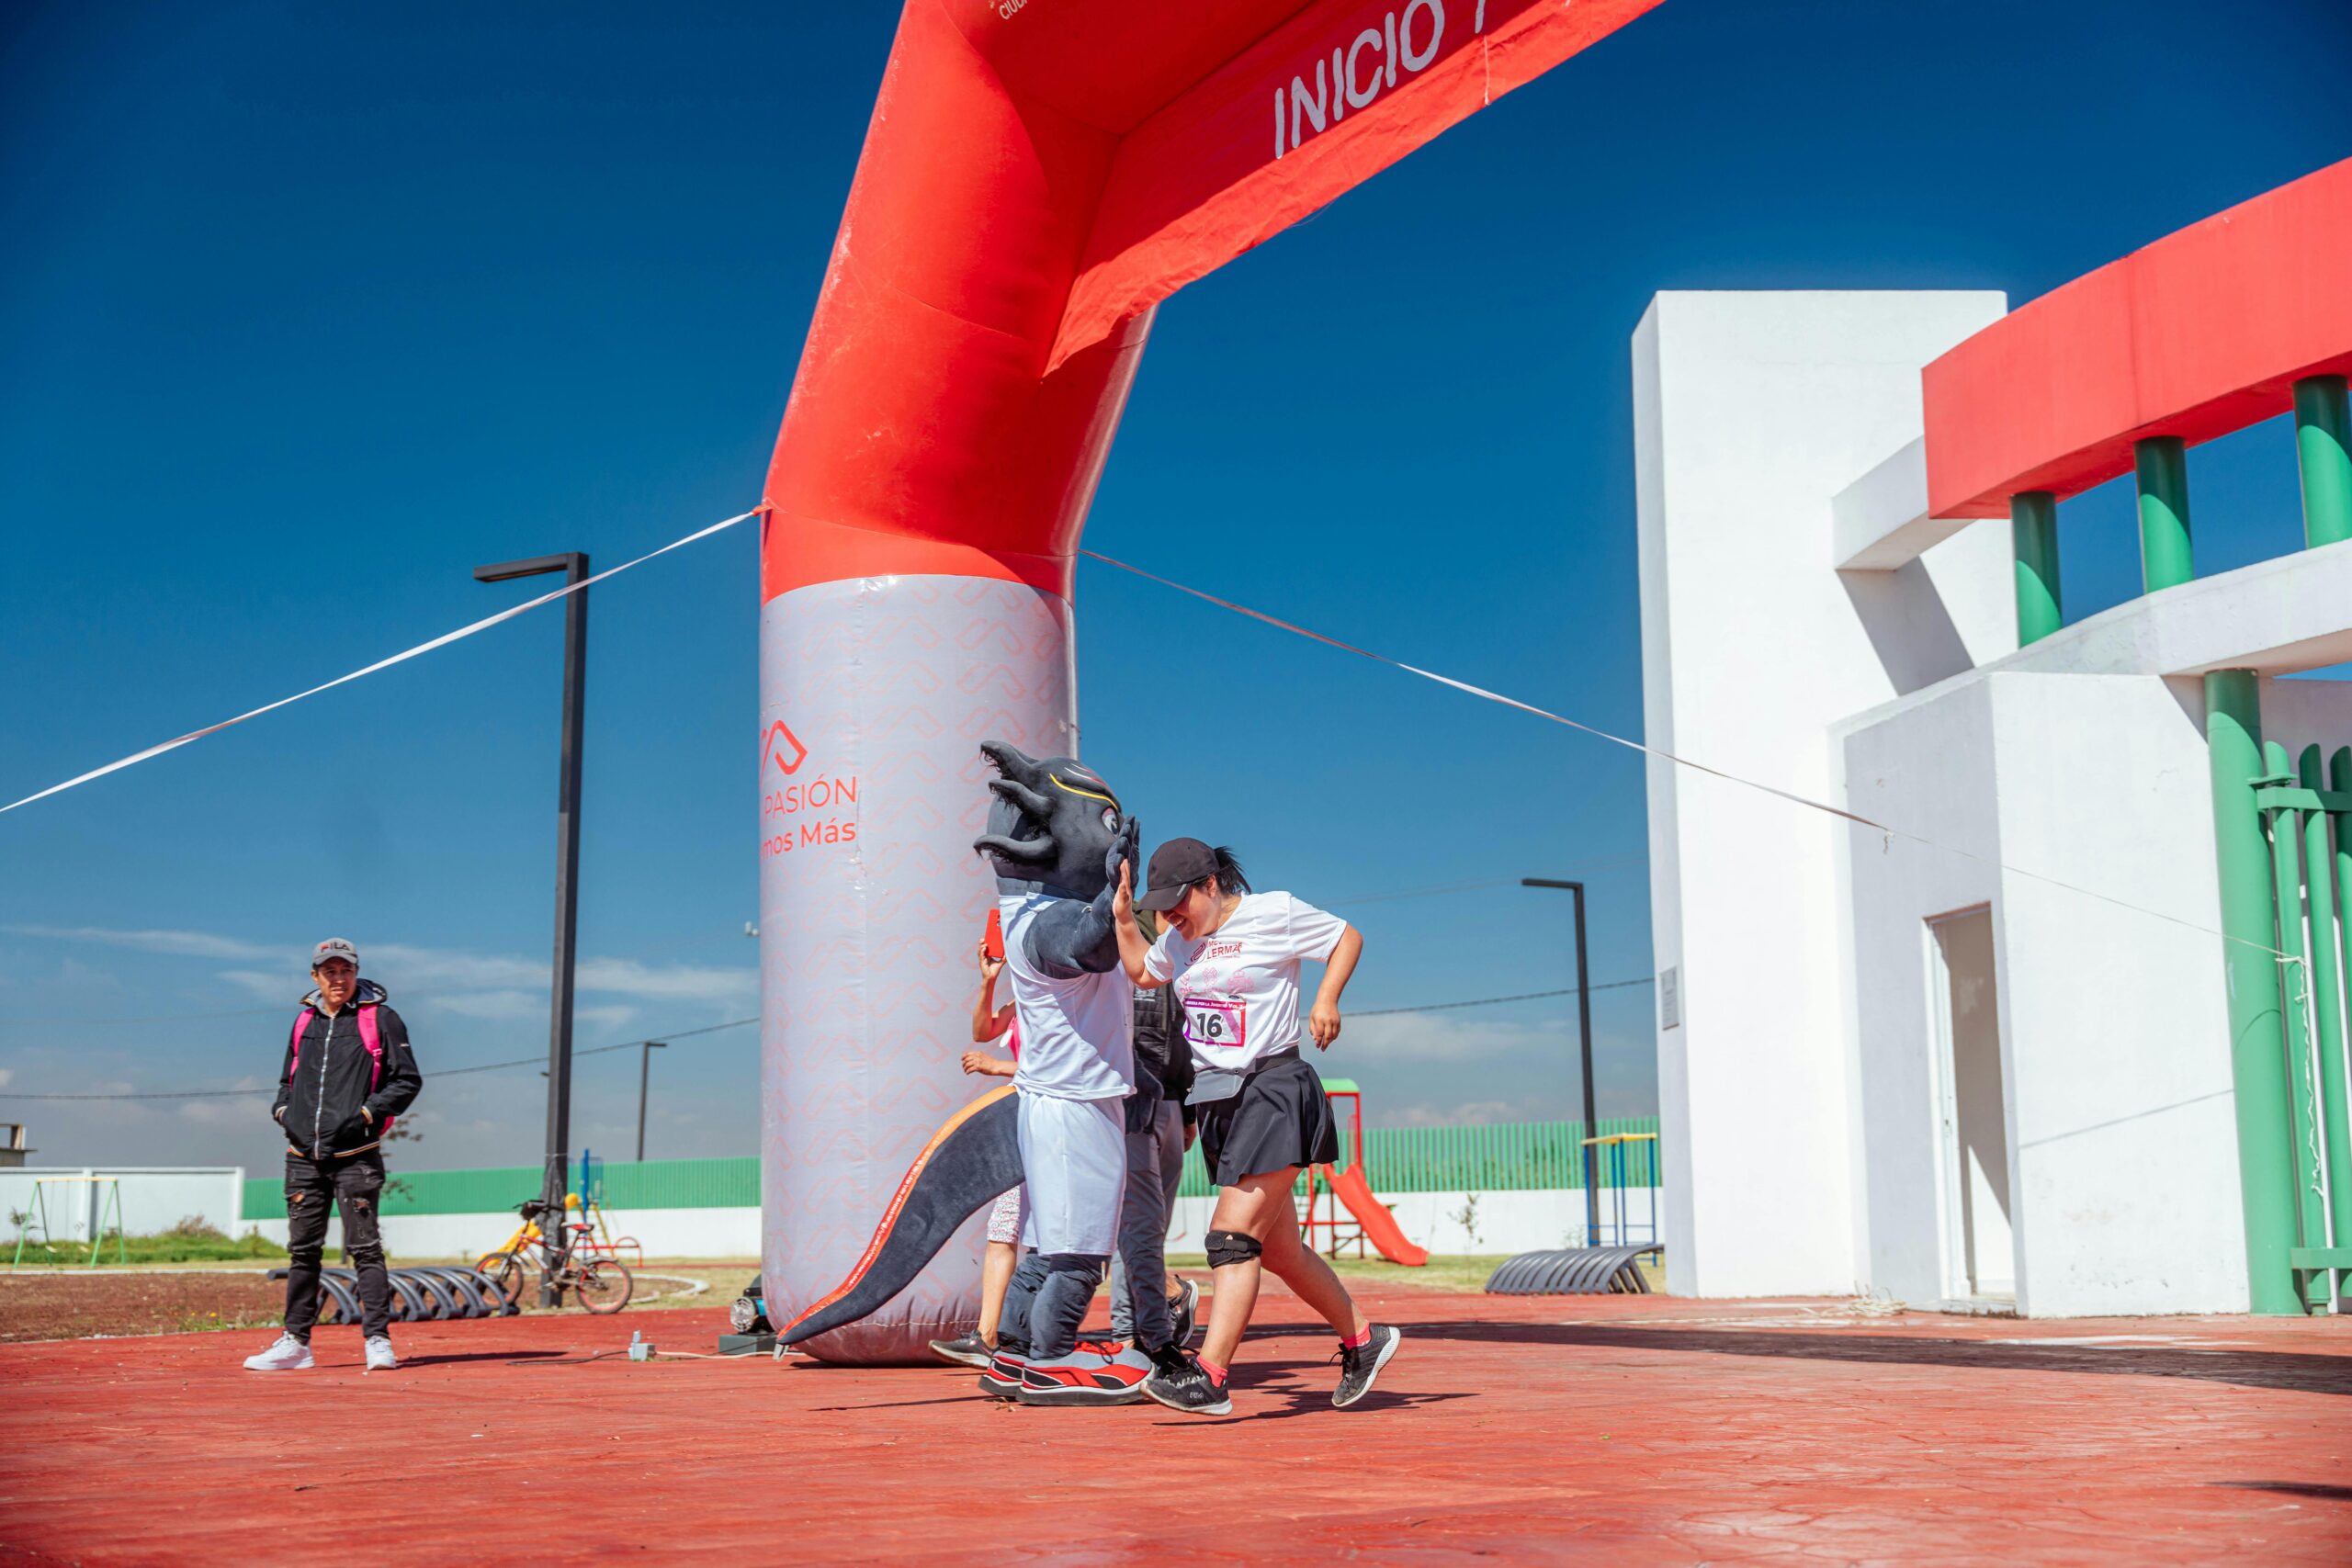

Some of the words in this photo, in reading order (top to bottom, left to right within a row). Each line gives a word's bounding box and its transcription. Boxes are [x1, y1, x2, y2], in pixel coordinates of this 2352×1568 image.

[1274, 0, 1445, 160] INICIO
[763, 773, 856, 823] PASIÓN
[800, 817, 856, 848] Más
[320, 942, 350, 953] FILA
[1196, 1013, 1223, 1038] 16
